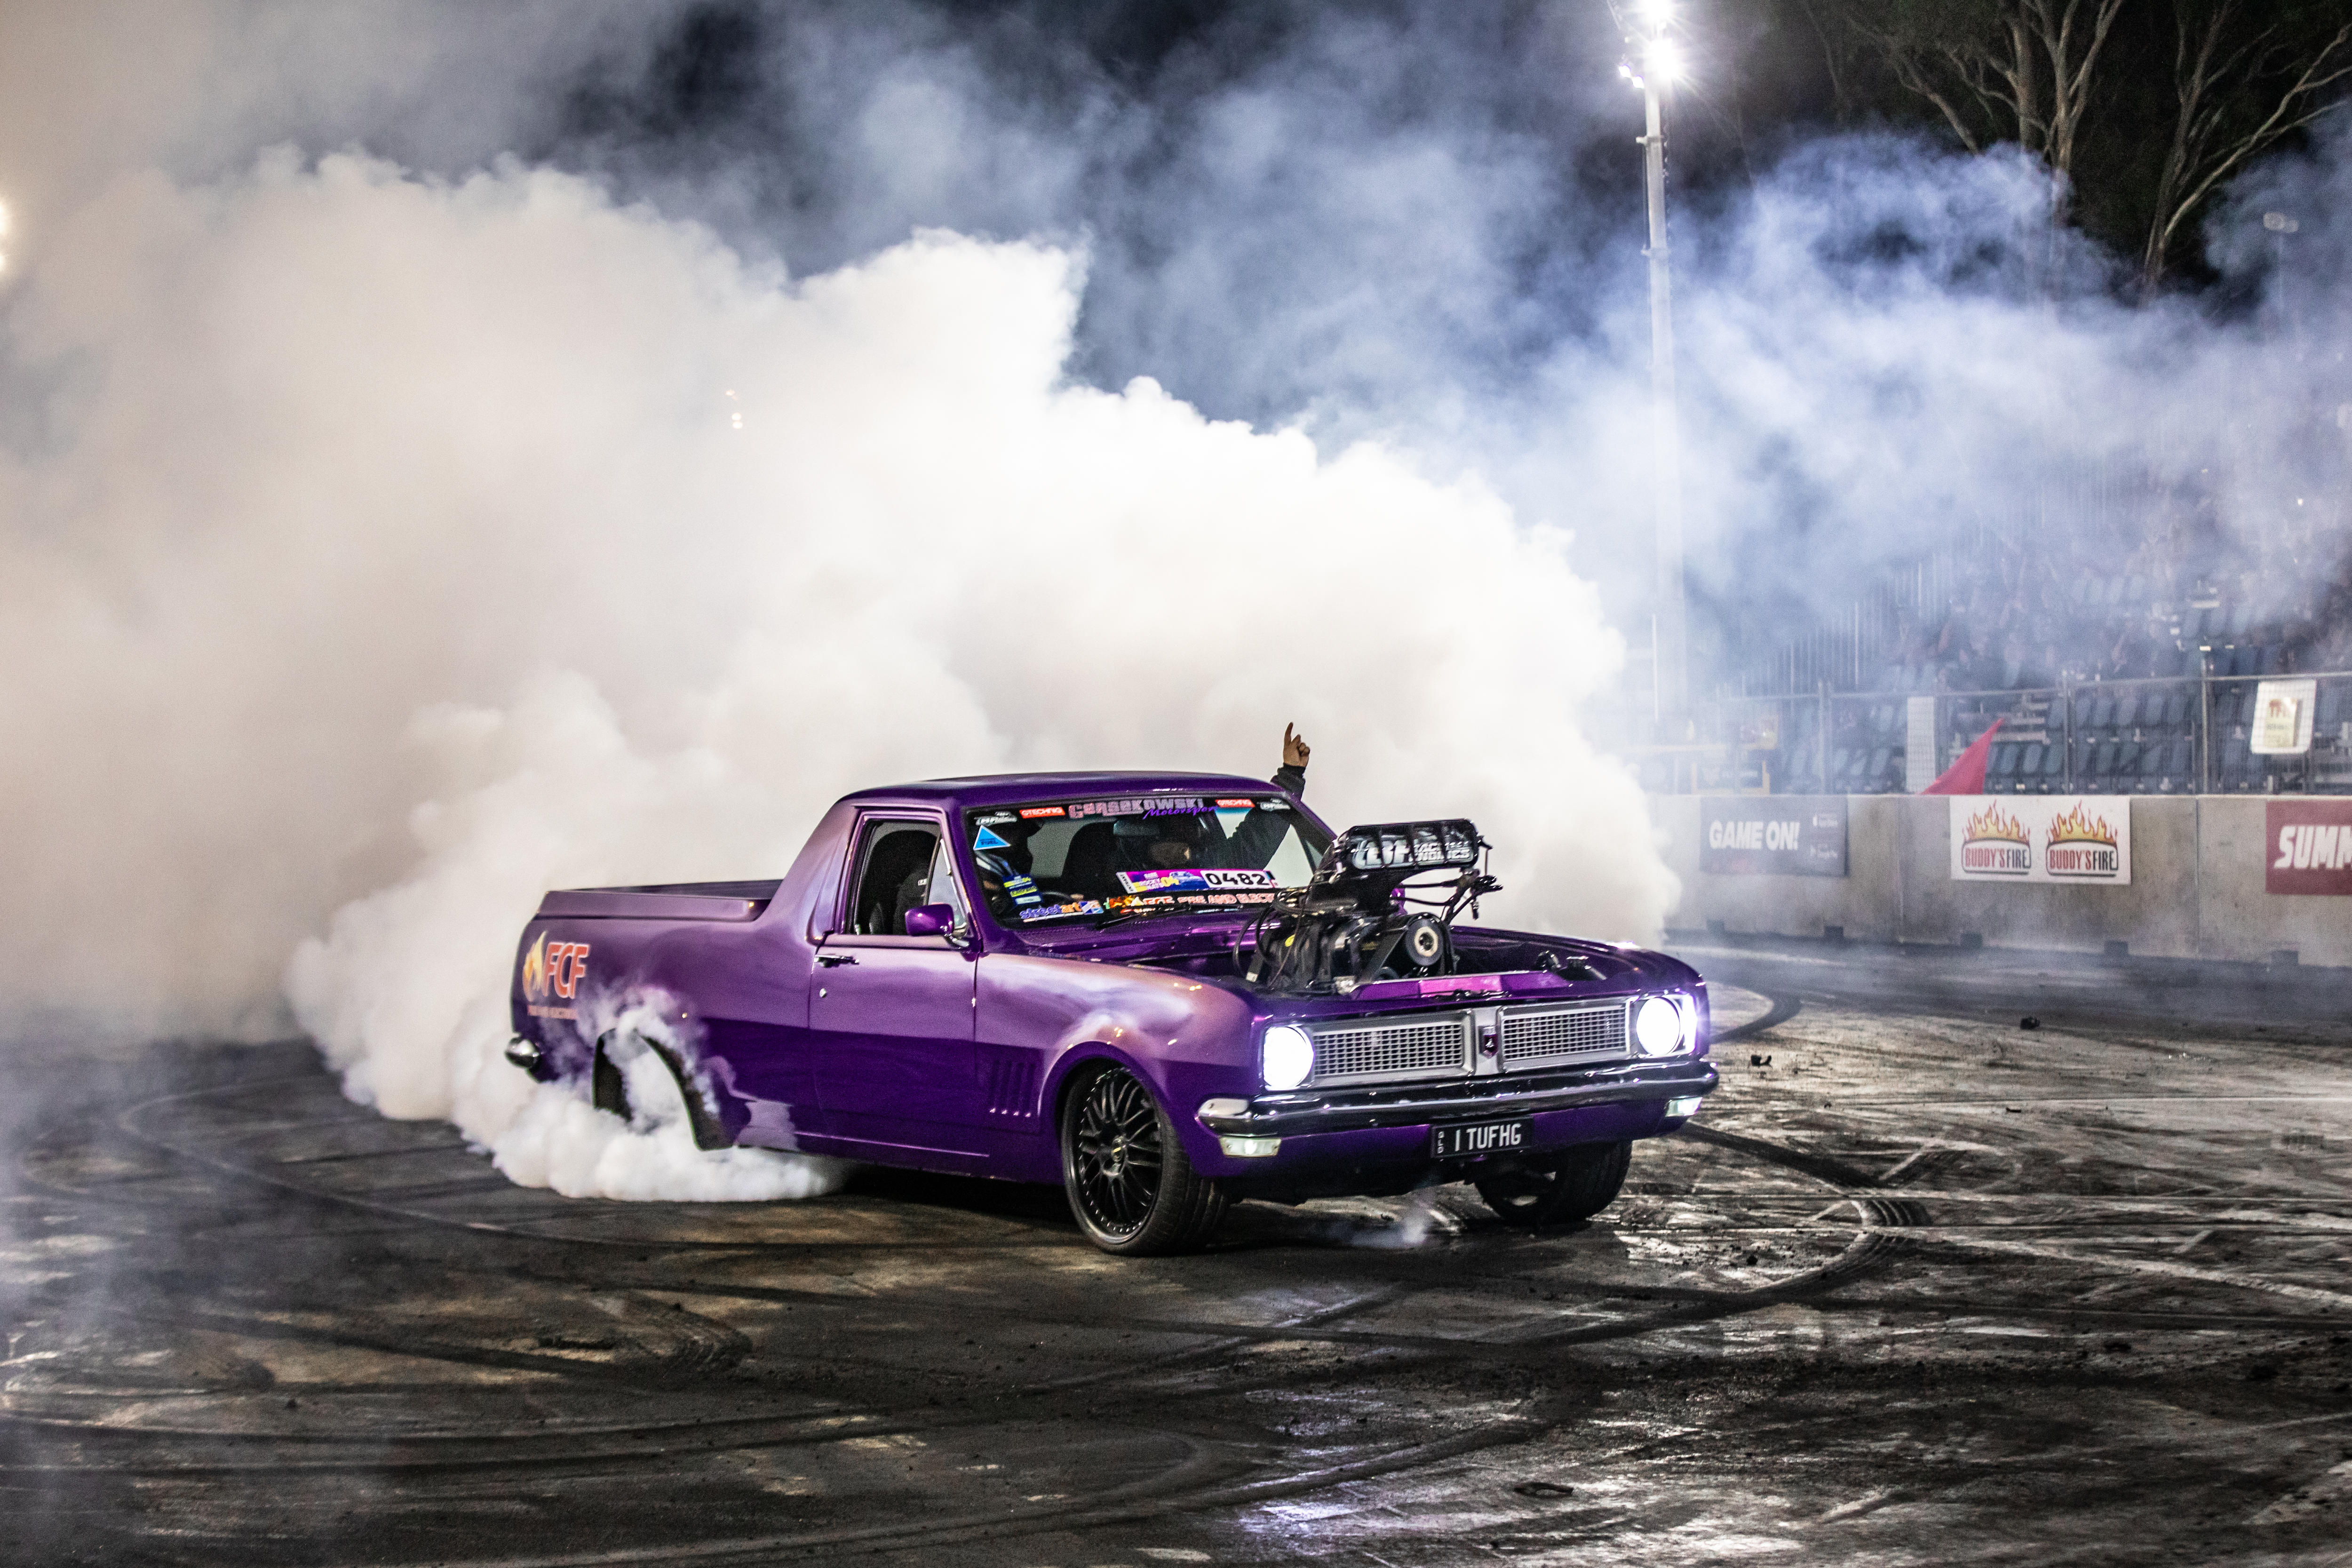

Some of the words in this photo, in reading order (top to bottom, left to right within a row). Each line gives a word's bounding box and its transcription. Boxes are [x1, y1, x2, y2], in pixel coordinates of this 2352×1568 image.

[1709, 820, 1764, 850] GAME
[1765, 820, 1800, 851] ON!
[2274, 826, 2352, 869] SUMM
[1205, 873, 1270, 885] 0482
[542, 941, 590, 999] FCF
